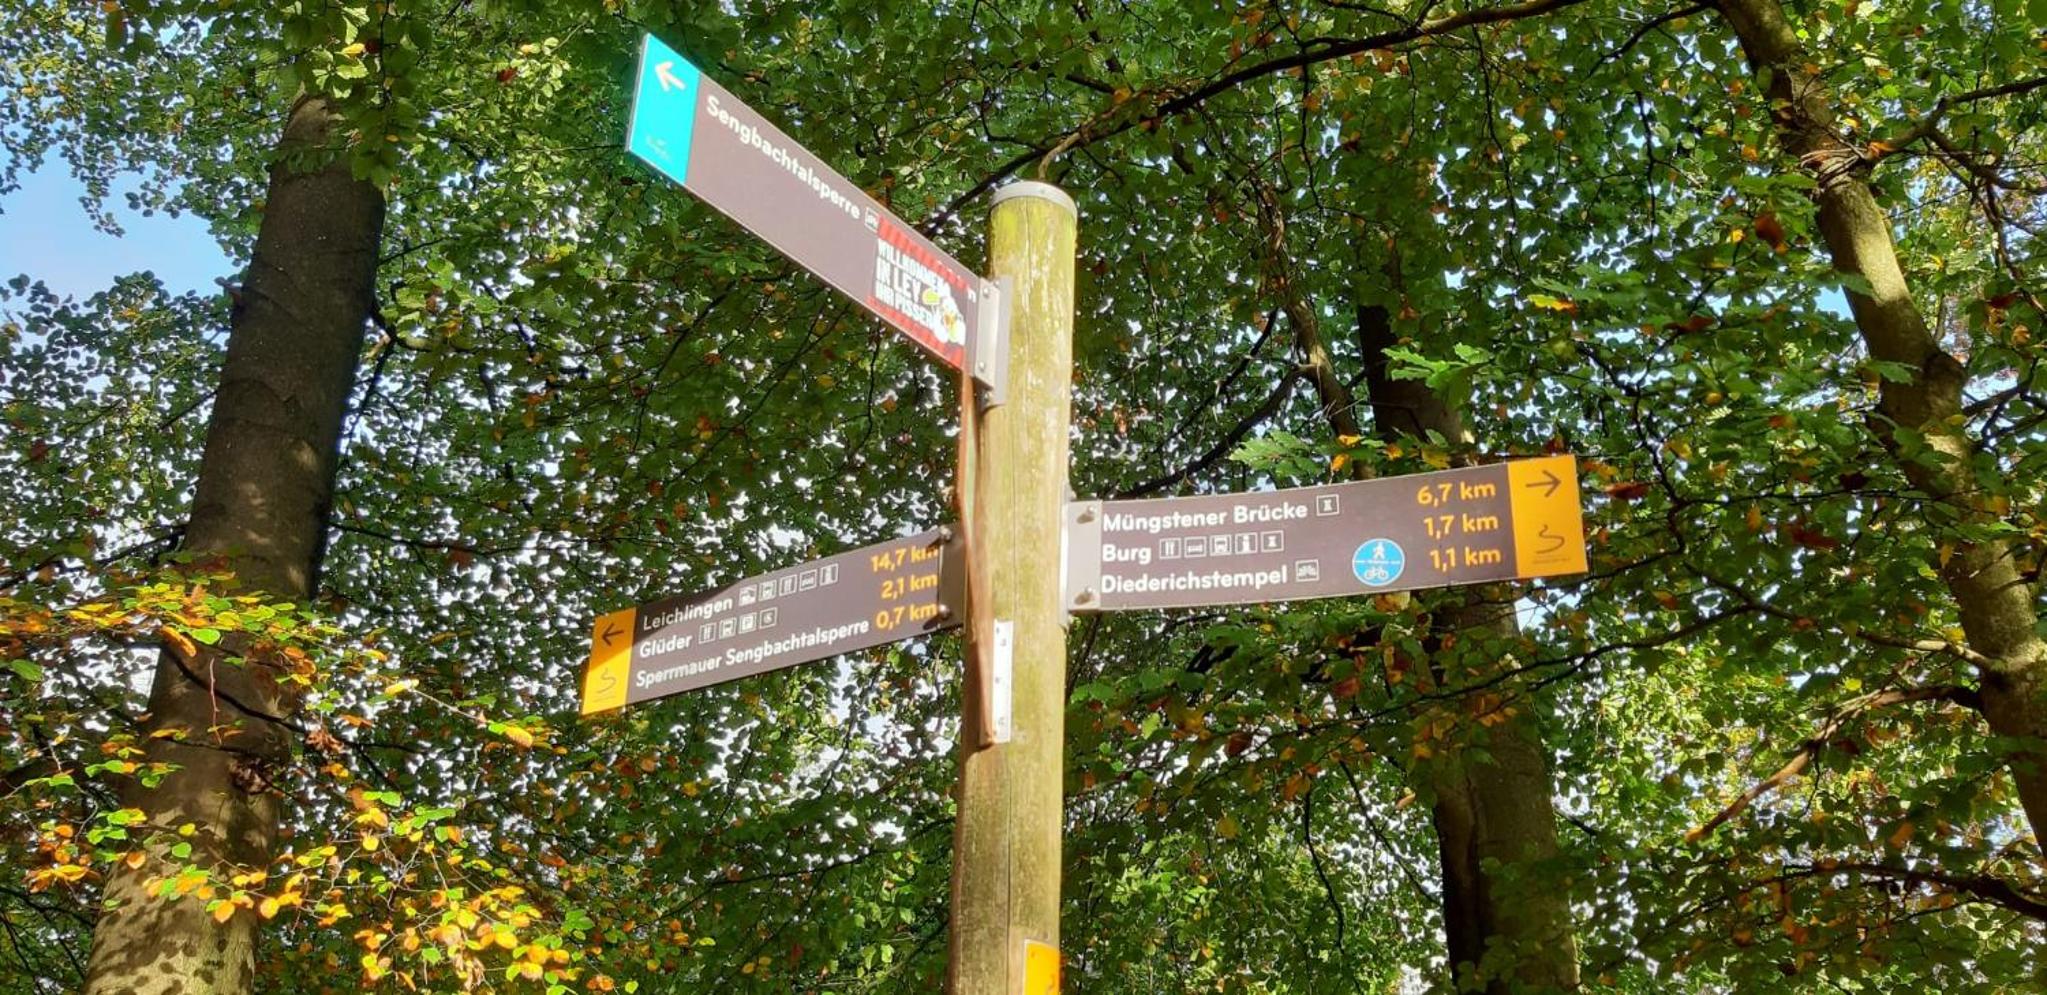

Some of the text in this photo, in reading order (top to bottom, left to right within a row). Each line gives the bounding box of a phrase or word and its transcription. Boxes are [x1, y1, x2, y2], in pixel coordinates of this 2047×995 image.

[706, 94, 861, 220] Sengbachtalsperre
[1417, 481, 1496, 507] 6,7 km
[1103, 501, 1308, 533] Müngstener Brücke
[1423, 513, 1499, 540] 1,7 km
[870, 547, 907, 573] 14,7
[1102, 543, 1152, 565] Burg
[1430, 546, 1501, 573] 1,1 km
[881, 573, 938, 600] 2,1 km
[1101, 565, 1288, 594] Diederichstempel
[643, 598, 733, 631] Leichlingen
[876, 602, 938, 630] 0,7 km
[635, 619, 870, 689] Sperrmauer Sengbachtalsperre
[639, 633, 693, 659] Glüder
